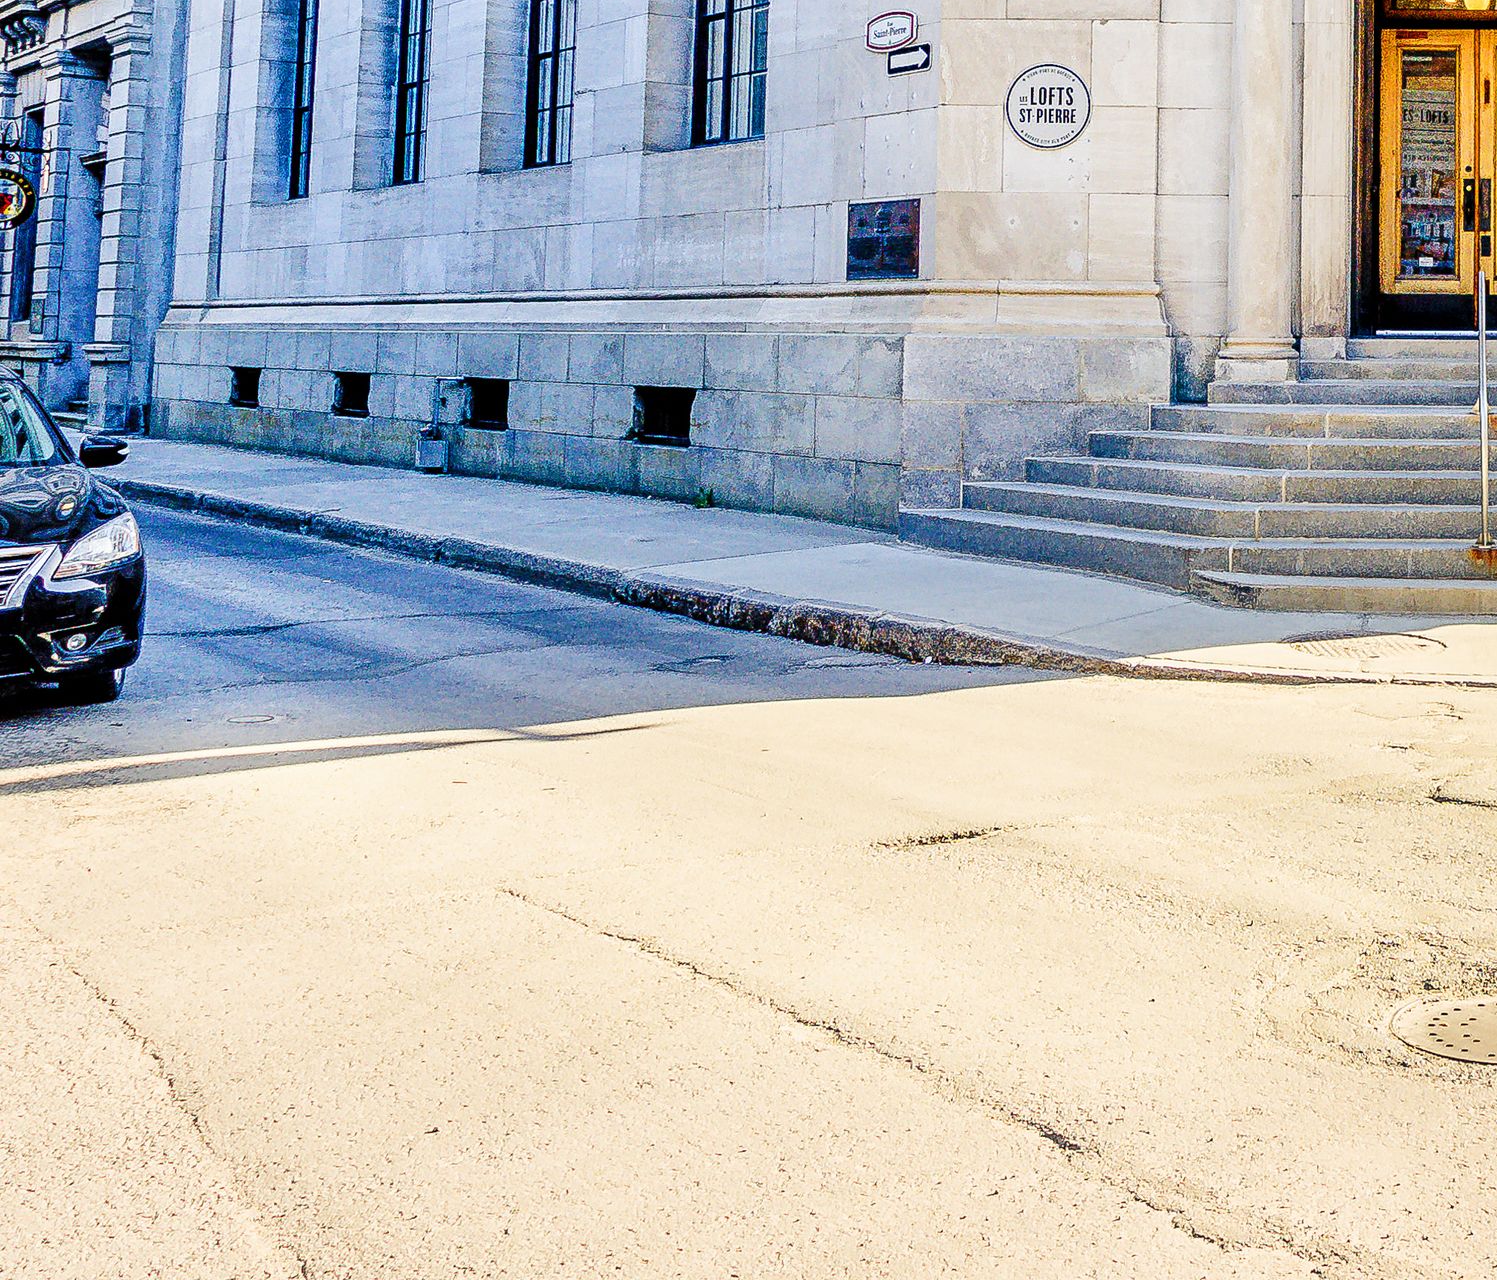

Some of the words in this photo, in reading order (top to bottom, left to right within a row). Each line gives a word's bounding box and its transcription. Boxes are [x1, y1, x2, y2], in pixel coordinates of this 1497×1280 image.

[873, 26, 908, 39] Saint-Pierre
[1030, 86, 1074, 106] LOFTS
[1420, 109, 1450, 125] LOFTS
